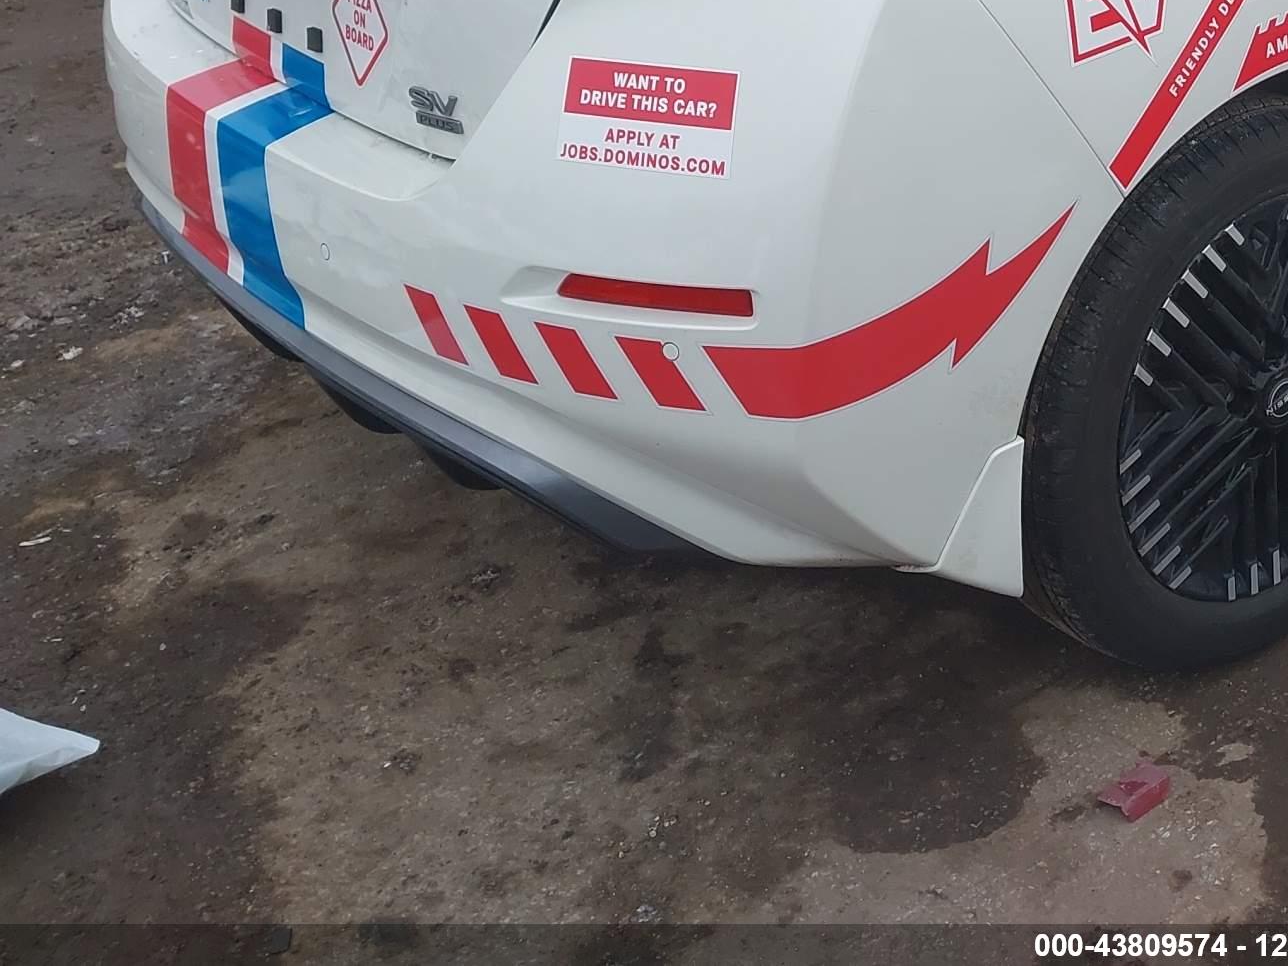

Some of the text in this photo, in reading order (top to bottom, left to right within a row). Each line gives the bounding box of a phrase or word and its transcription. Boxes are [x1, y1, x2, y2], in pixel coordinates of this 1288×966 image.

[353, 10, 366, 28] ON
[345, 24, 374, 52] BOARD
[1168, 17, 1221, 97] FRIENDLY
[613, 72, 686, 94] WANT TO
[409, 86, 458, 116] SV
[580, 89, 717, 118] DRIVE THIS CAR?
[419, 114, 456, 131] PLUS
[604, 128, 680, 150] APPLY AT
[560, 143, 726, 176] JOBS.DOMINOS.COM
